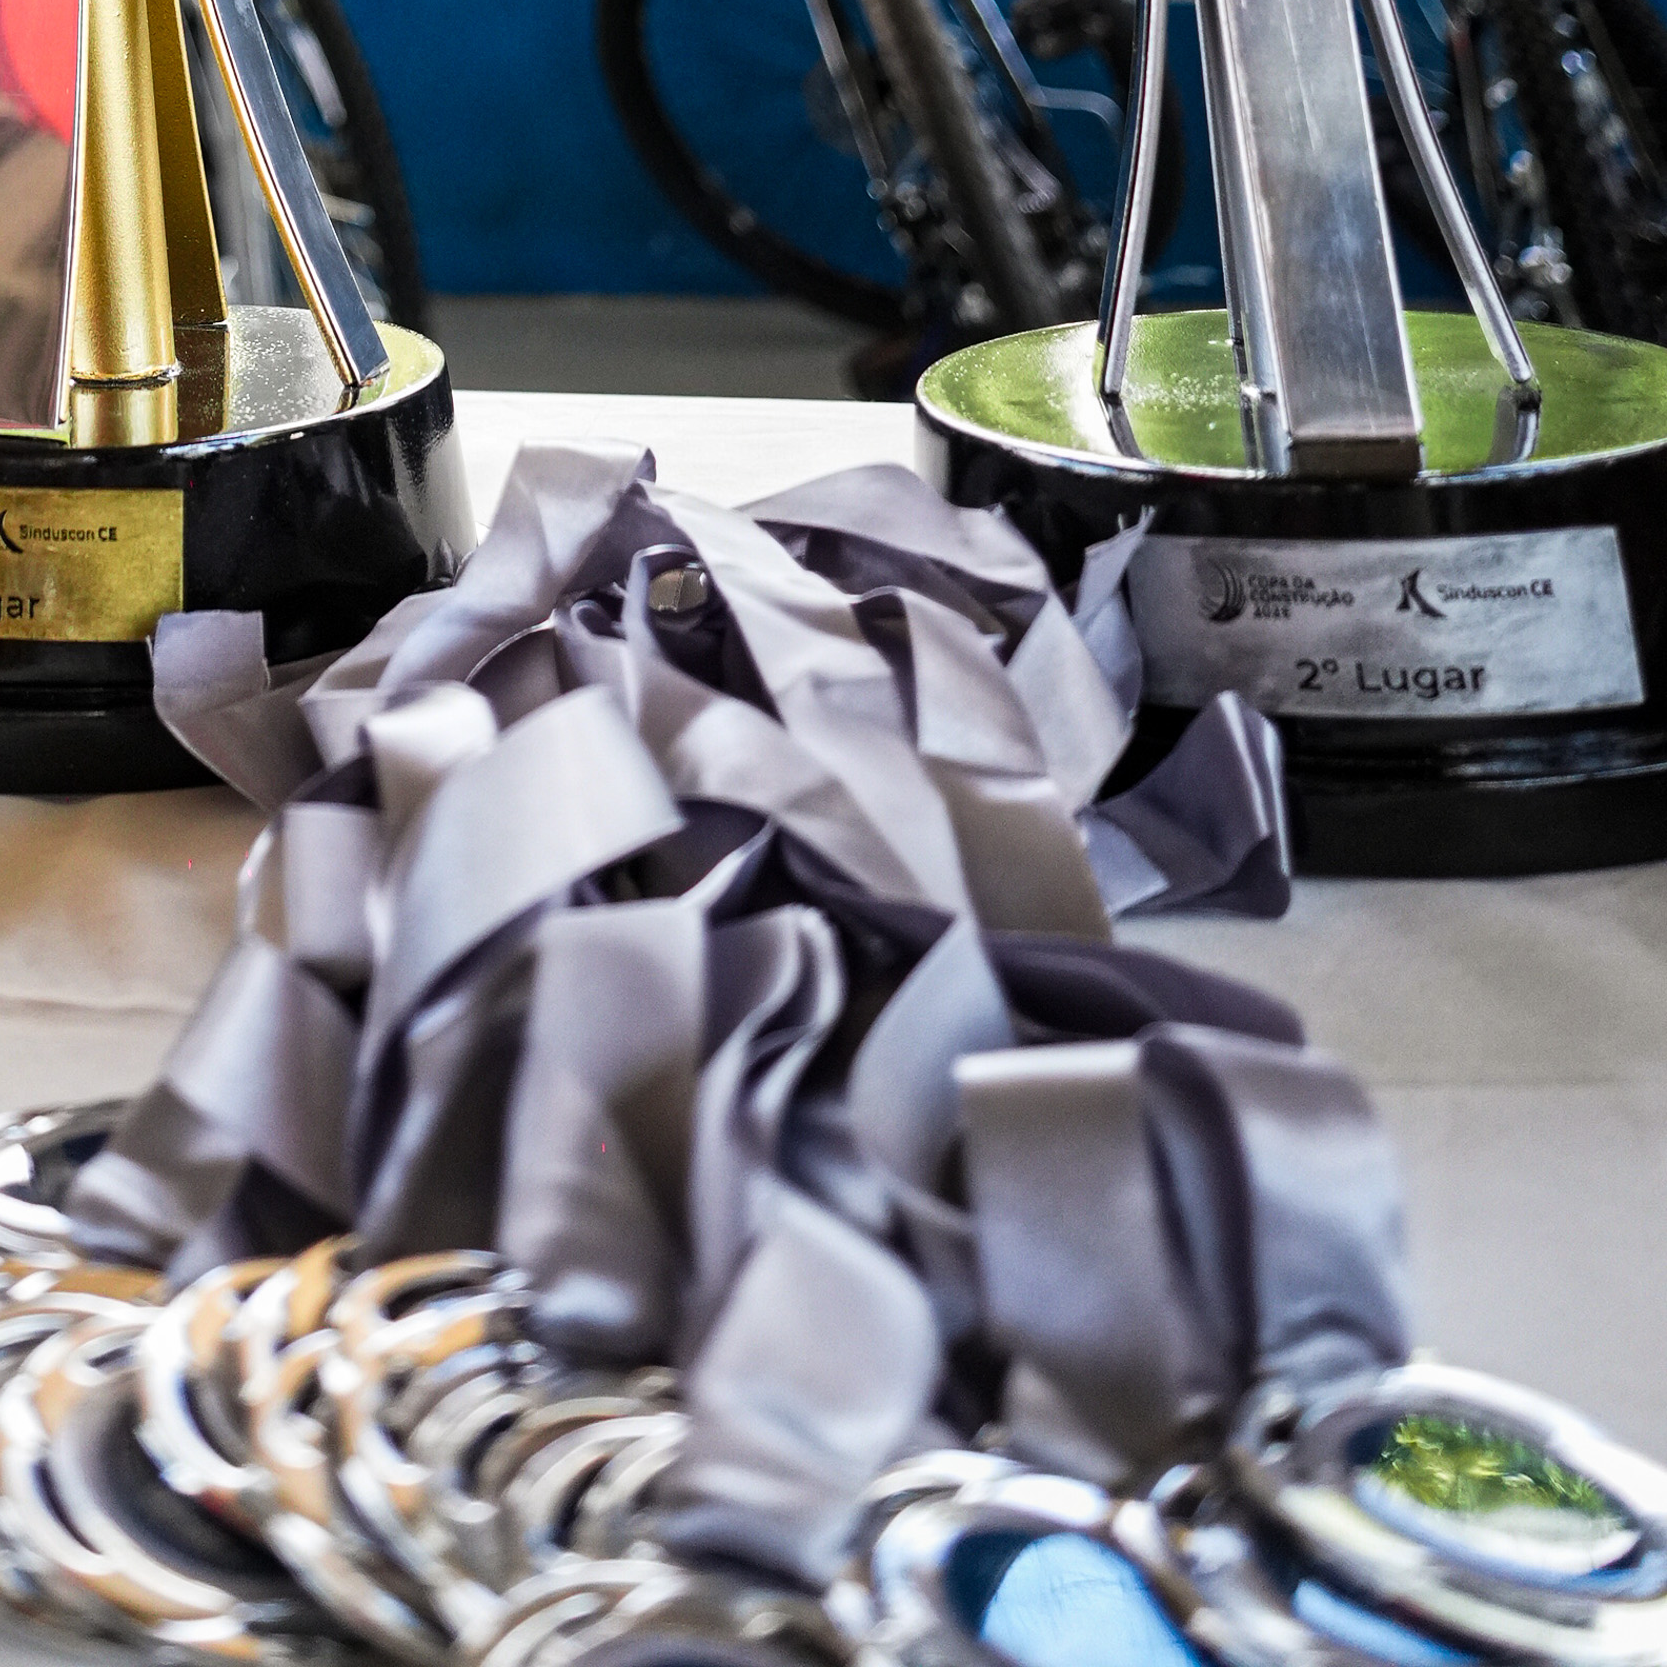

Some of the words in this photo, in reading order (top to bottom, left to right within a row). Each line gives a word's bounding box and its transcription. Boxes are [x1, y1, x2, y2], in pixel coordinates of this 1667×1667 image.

[19, 524, 95, 542] Sinduscon
[98, 526, 117, 542] CE
[1437, 583, 1527, 602] Sinduscon
[1531, 579, 1554, 598] CE
[1295, 658, 1338, 692] 2º
[1354, 661, 1485, 700] Lugar
